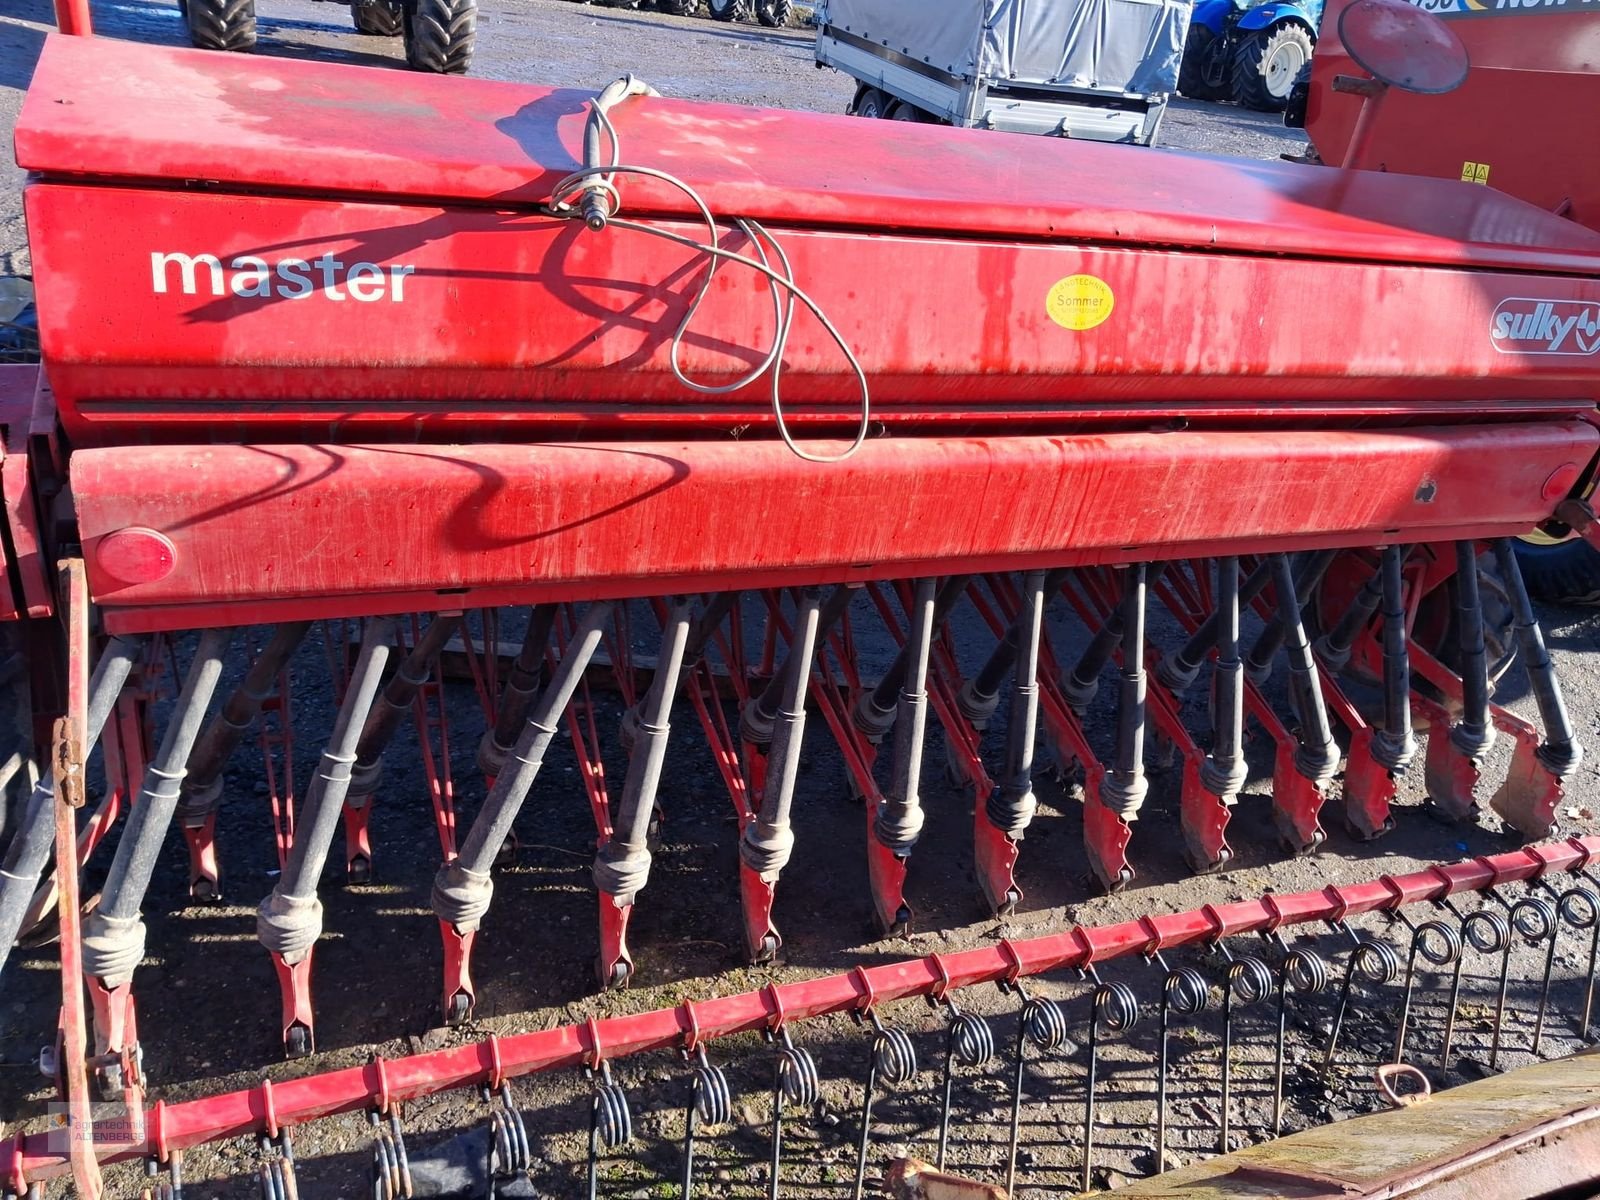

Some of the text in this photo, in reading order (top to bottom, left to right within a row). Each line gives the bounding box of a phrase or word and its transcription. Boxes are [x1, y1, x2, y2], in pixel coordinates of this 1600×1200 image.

[151, 251, 415, 302] master
[1056, 294, 1104, 307] Sommer
[1492, 303, 1578, 351] sulky
